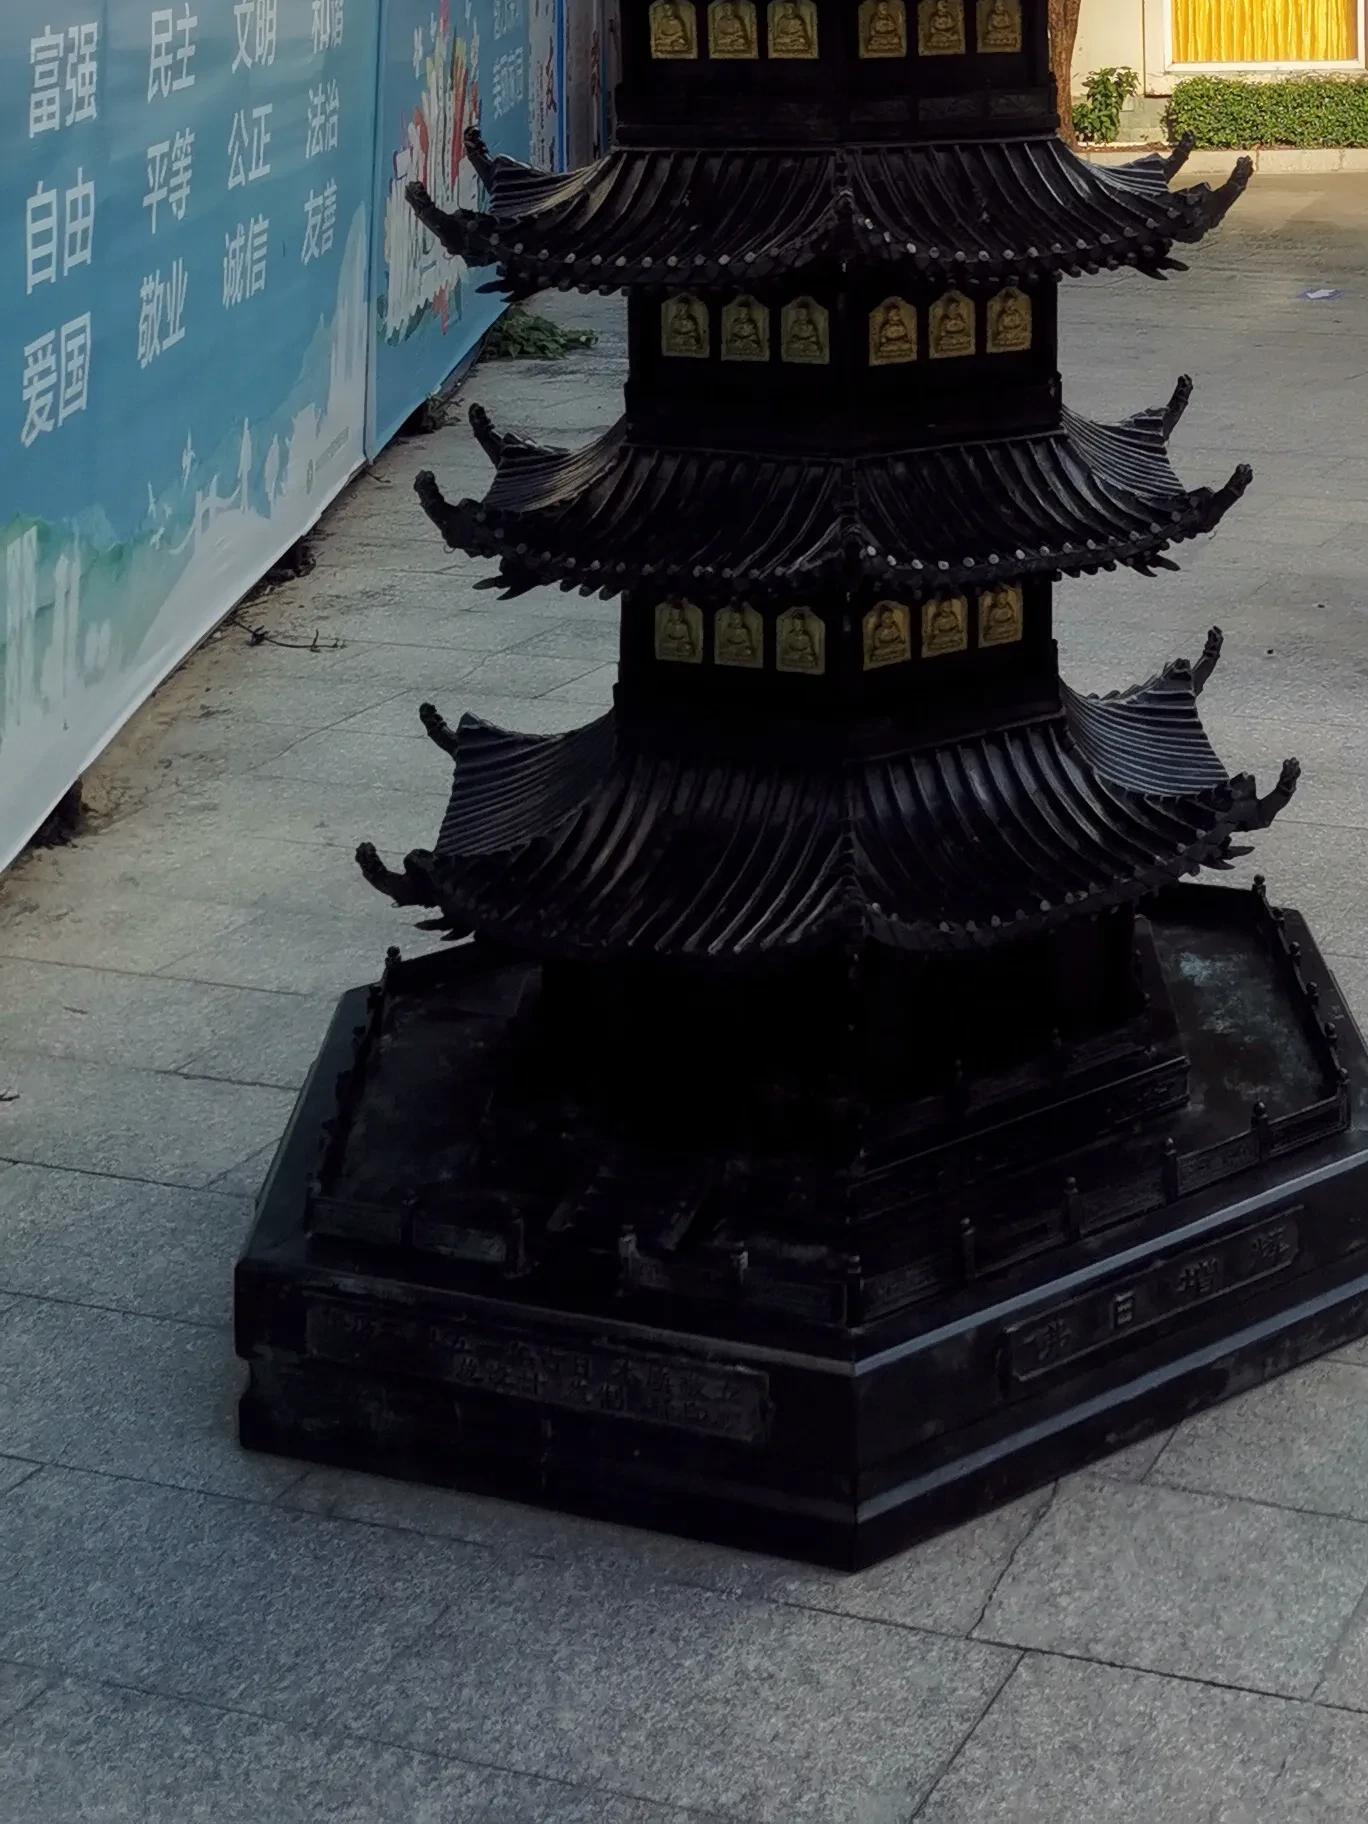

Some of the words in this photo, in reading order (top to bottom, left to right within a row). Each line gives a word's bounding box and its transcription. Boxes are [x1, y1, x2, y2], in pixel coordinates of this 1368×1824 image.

[29, 21, 98, 139] 富强
[147, 2, 198, 104] 民主
[227, 103, 273, 191] 公正
[305, 78, 340, 159] 法治
[26, 167, 95, 296] 自由
[142, 127, 195, 234] 平等
[301, 178, 338, 266] 友善
[137, 257, 188, 369] 敬业
[222, 213, 270, 310] 诚信
[20, 311, 91, 448] 爱国
